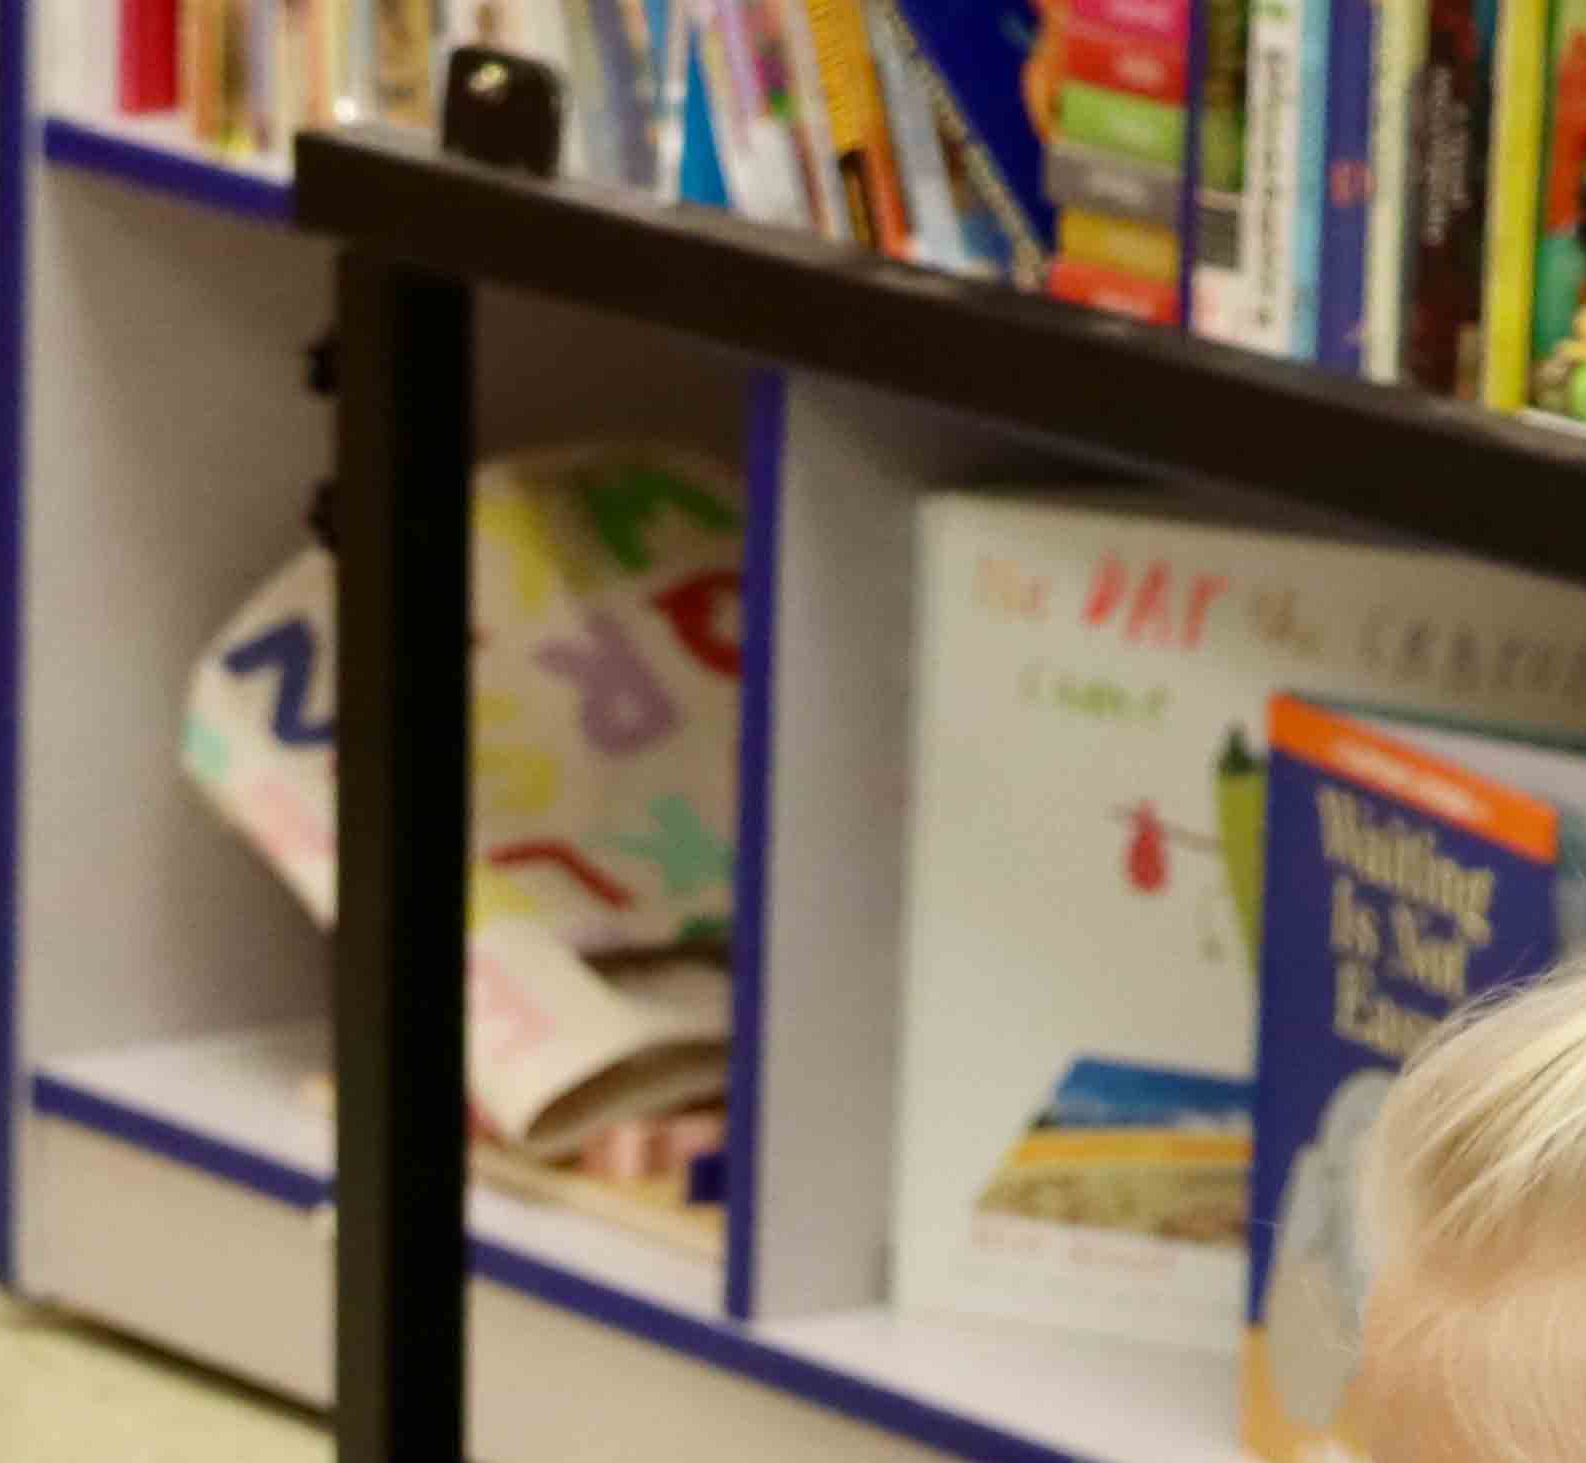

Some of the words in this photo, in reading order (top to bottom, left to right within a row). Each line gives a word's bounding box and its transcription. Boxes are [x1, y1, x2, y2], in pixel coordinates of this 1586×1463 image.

[1083, 550, 1221, 650] DAY
[1316, 784, 1495, 948] Waiting
[1331, 872, 1380, 957] Is
[1391, 901, 1469, 997] Not
